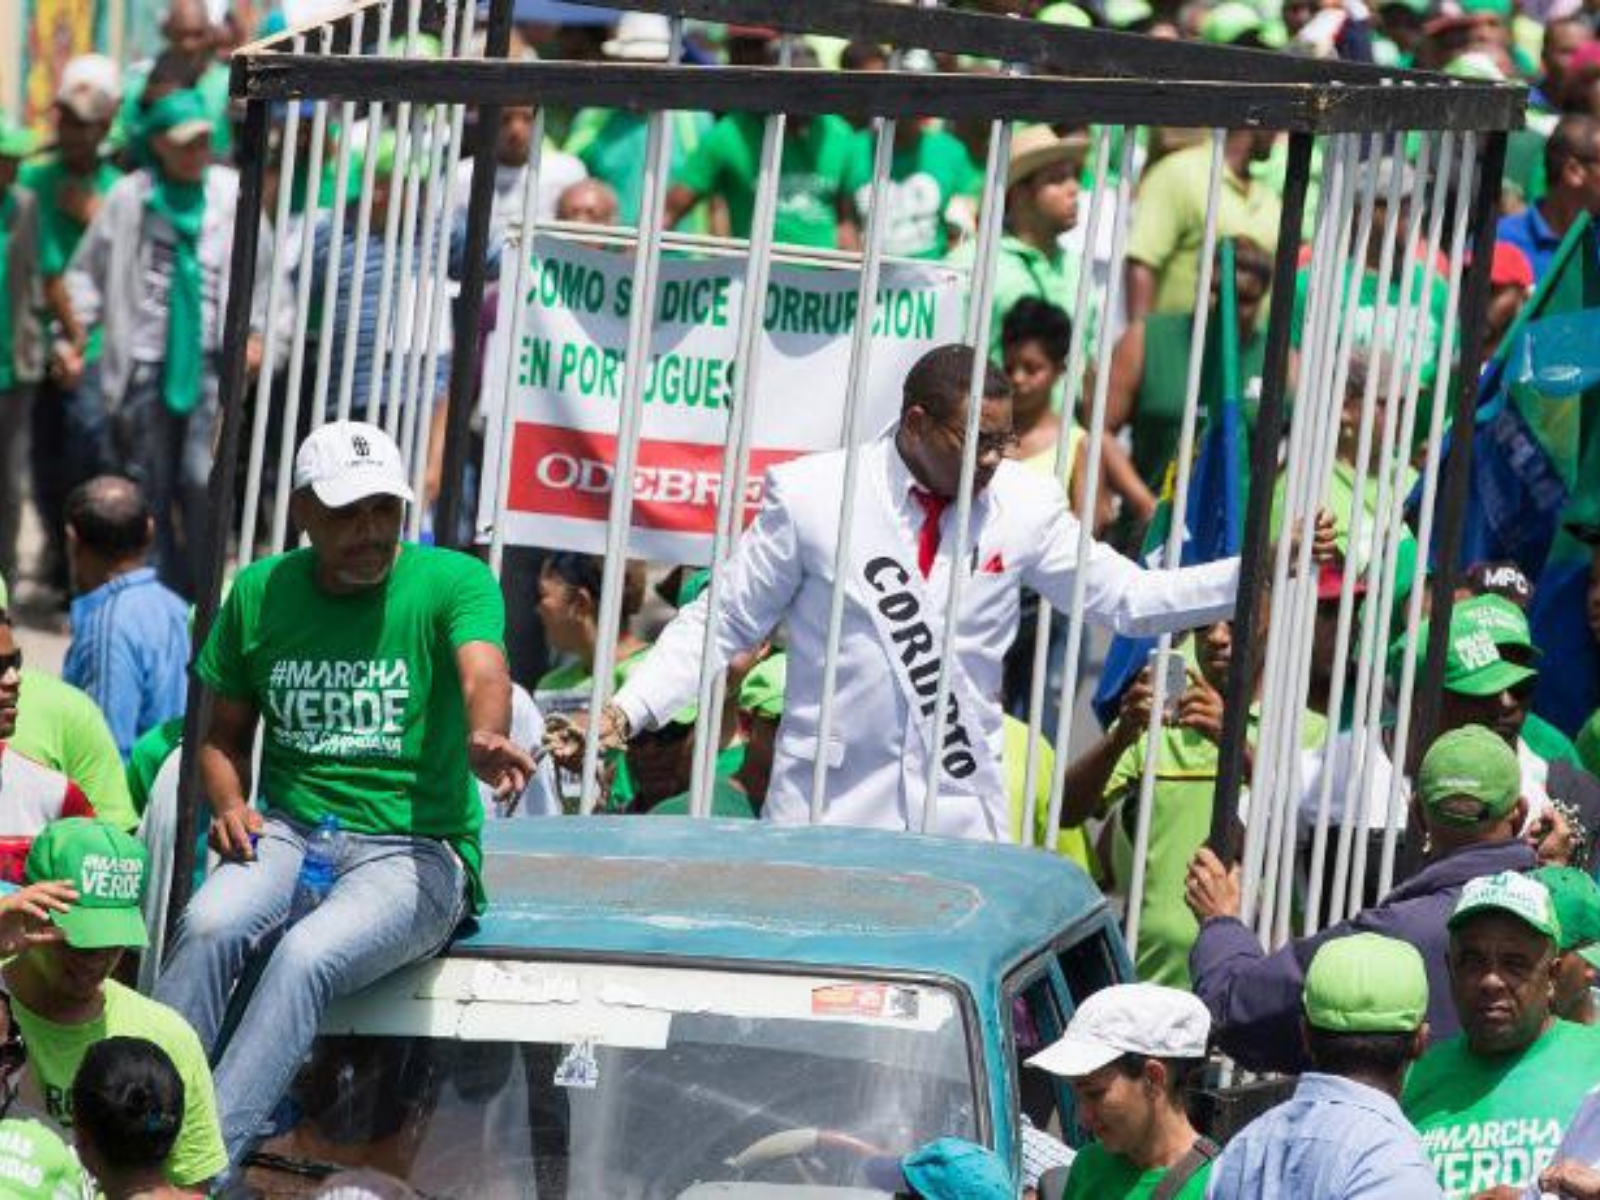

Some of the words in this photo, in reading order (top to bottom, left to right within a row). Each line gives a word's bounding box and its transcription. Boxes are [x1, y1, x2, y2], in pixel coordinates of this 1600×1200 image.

[660, 277, 731, 327] DICE
[270, 658, 409, 688] #MARCHA
[267, 689, 410, 735] VERDE
[82, 869, 141, 899] VERDE
